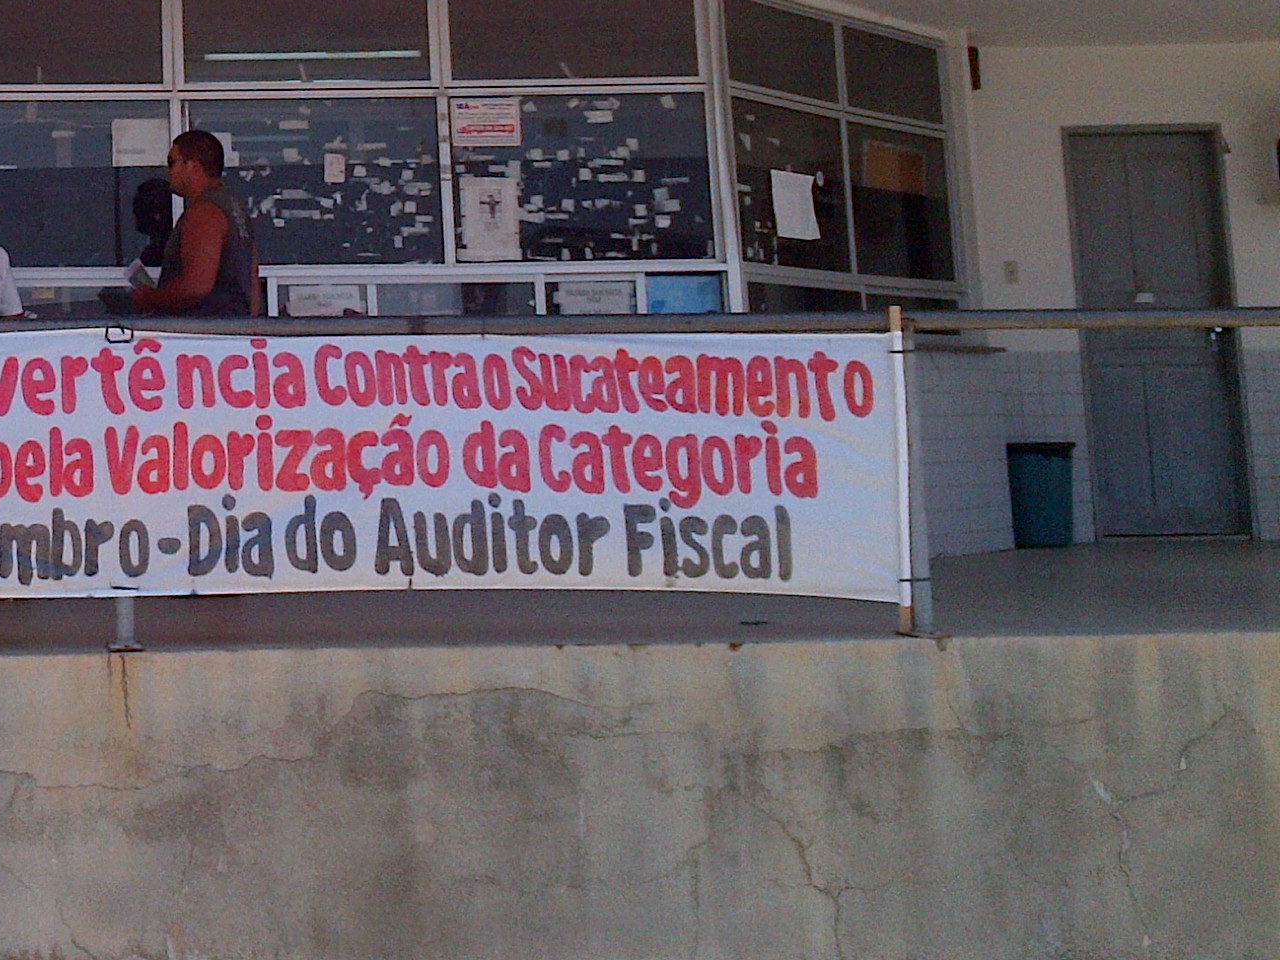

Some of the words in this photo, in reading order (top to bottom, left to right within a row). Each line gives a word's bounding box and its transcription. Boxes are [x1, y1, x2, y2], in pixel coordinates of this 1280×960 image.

[513, 346, 874, 422] Sucateamento
[104, 413, 450, 499] Valorização
[462, 420, 532, 494] da
[538, 422, 819, 510] Categoria
[284, 494, 357, 575] do
[374, 492, 611, 578] Auditor
[623, 497, 793, 582] Fiscal
